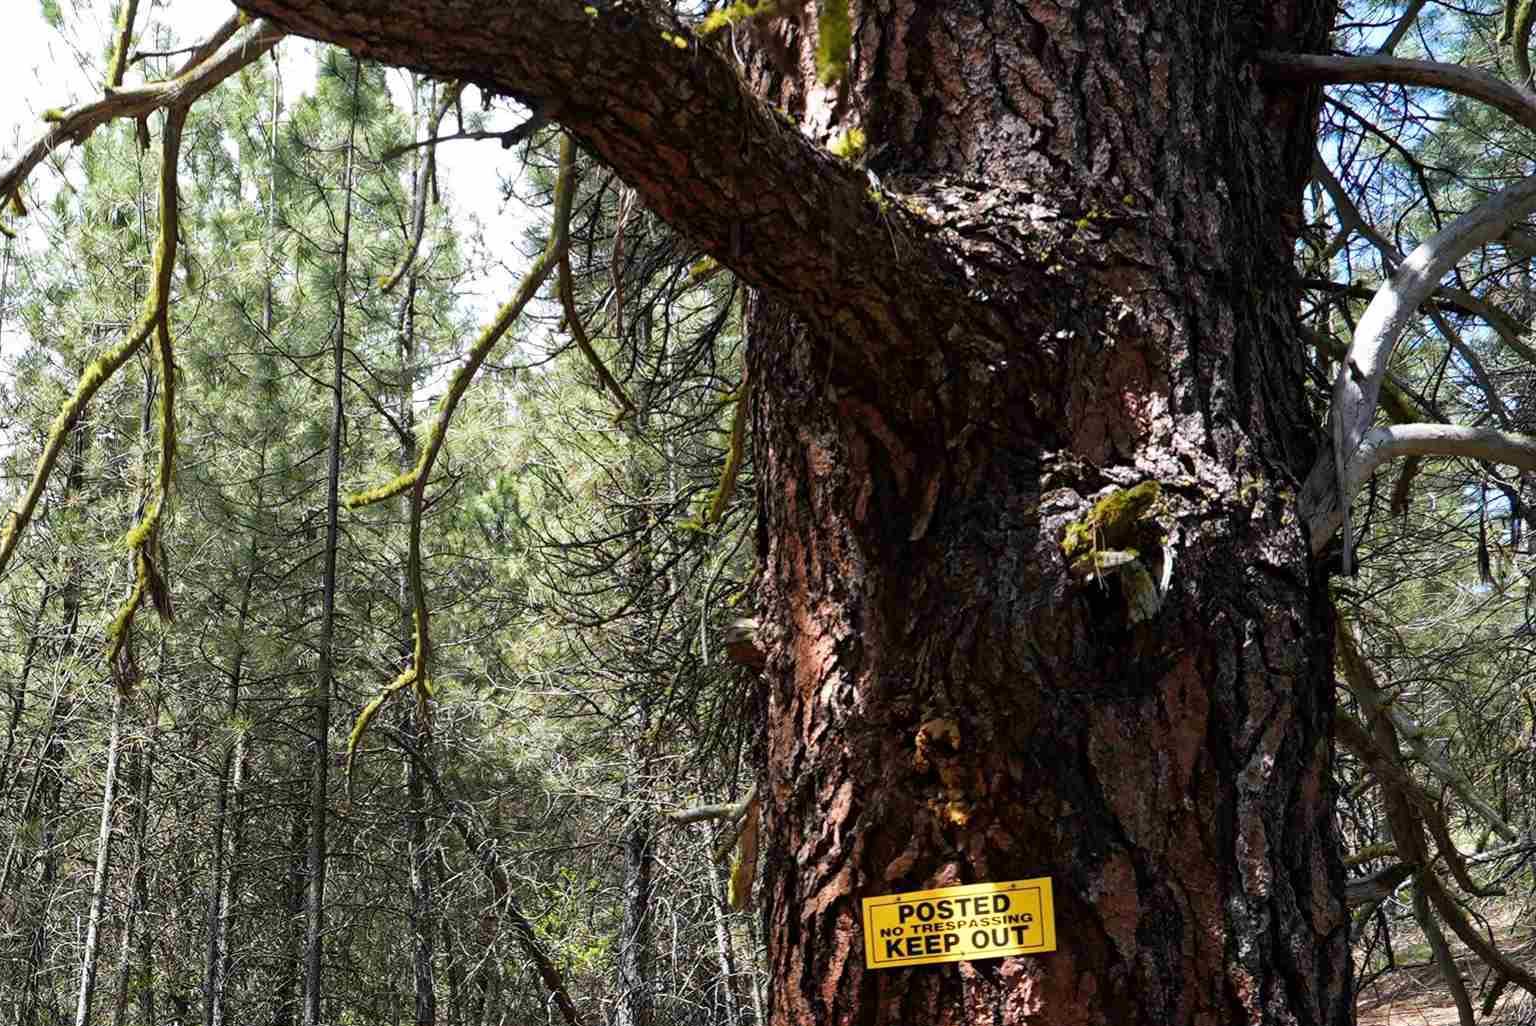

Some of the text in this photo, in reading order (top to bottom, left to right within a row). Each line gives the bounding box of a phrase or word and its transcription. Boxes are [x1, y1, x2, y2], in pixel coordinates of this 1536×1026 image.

[898, 894, 1011, 924] POSTED
[880, 912, 1033, 938] NO TRESPASSING
[885, 925, 1030, 958] KEEP OUT
